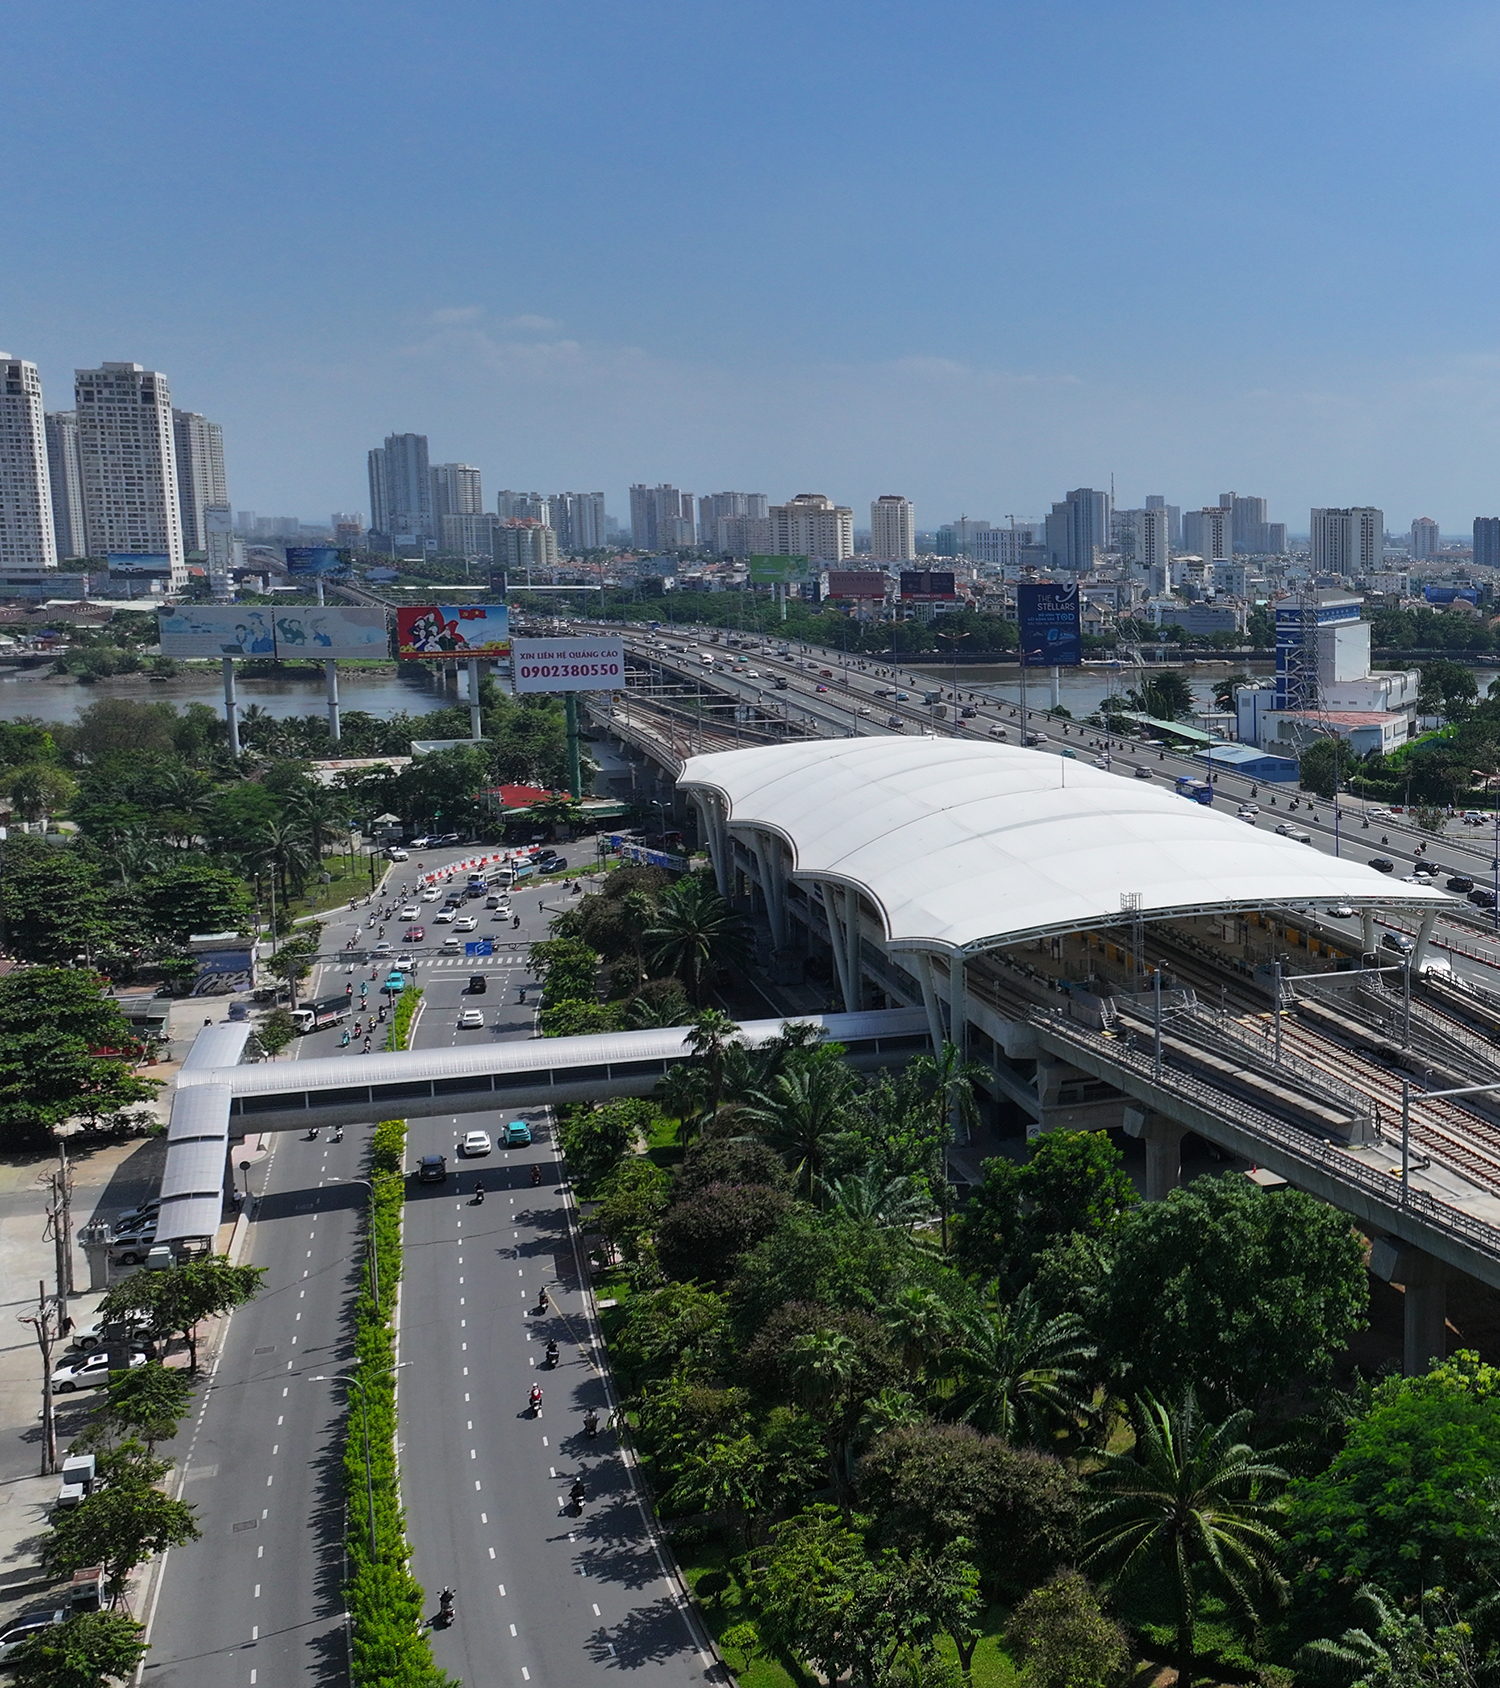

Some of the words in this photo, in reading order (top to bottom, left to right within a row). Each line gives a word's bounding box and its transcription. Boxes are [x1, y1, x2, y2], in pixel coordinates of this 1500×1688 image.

[1037, 594, 1052, 603] THE
[1055, 576, 1078, 603] 9
[1037, 602, 1076, 611] STELLARS
[1055, 613, 1075, 621] TOD
[537, 651, 554, 660] LIÊN
[556, 650, 567, 659] HỆ
[569, 649, 599, 659] QUẢNG
[600, 649, 619, 658] CÁO
[521, 663, 619, 678] 0902380550
